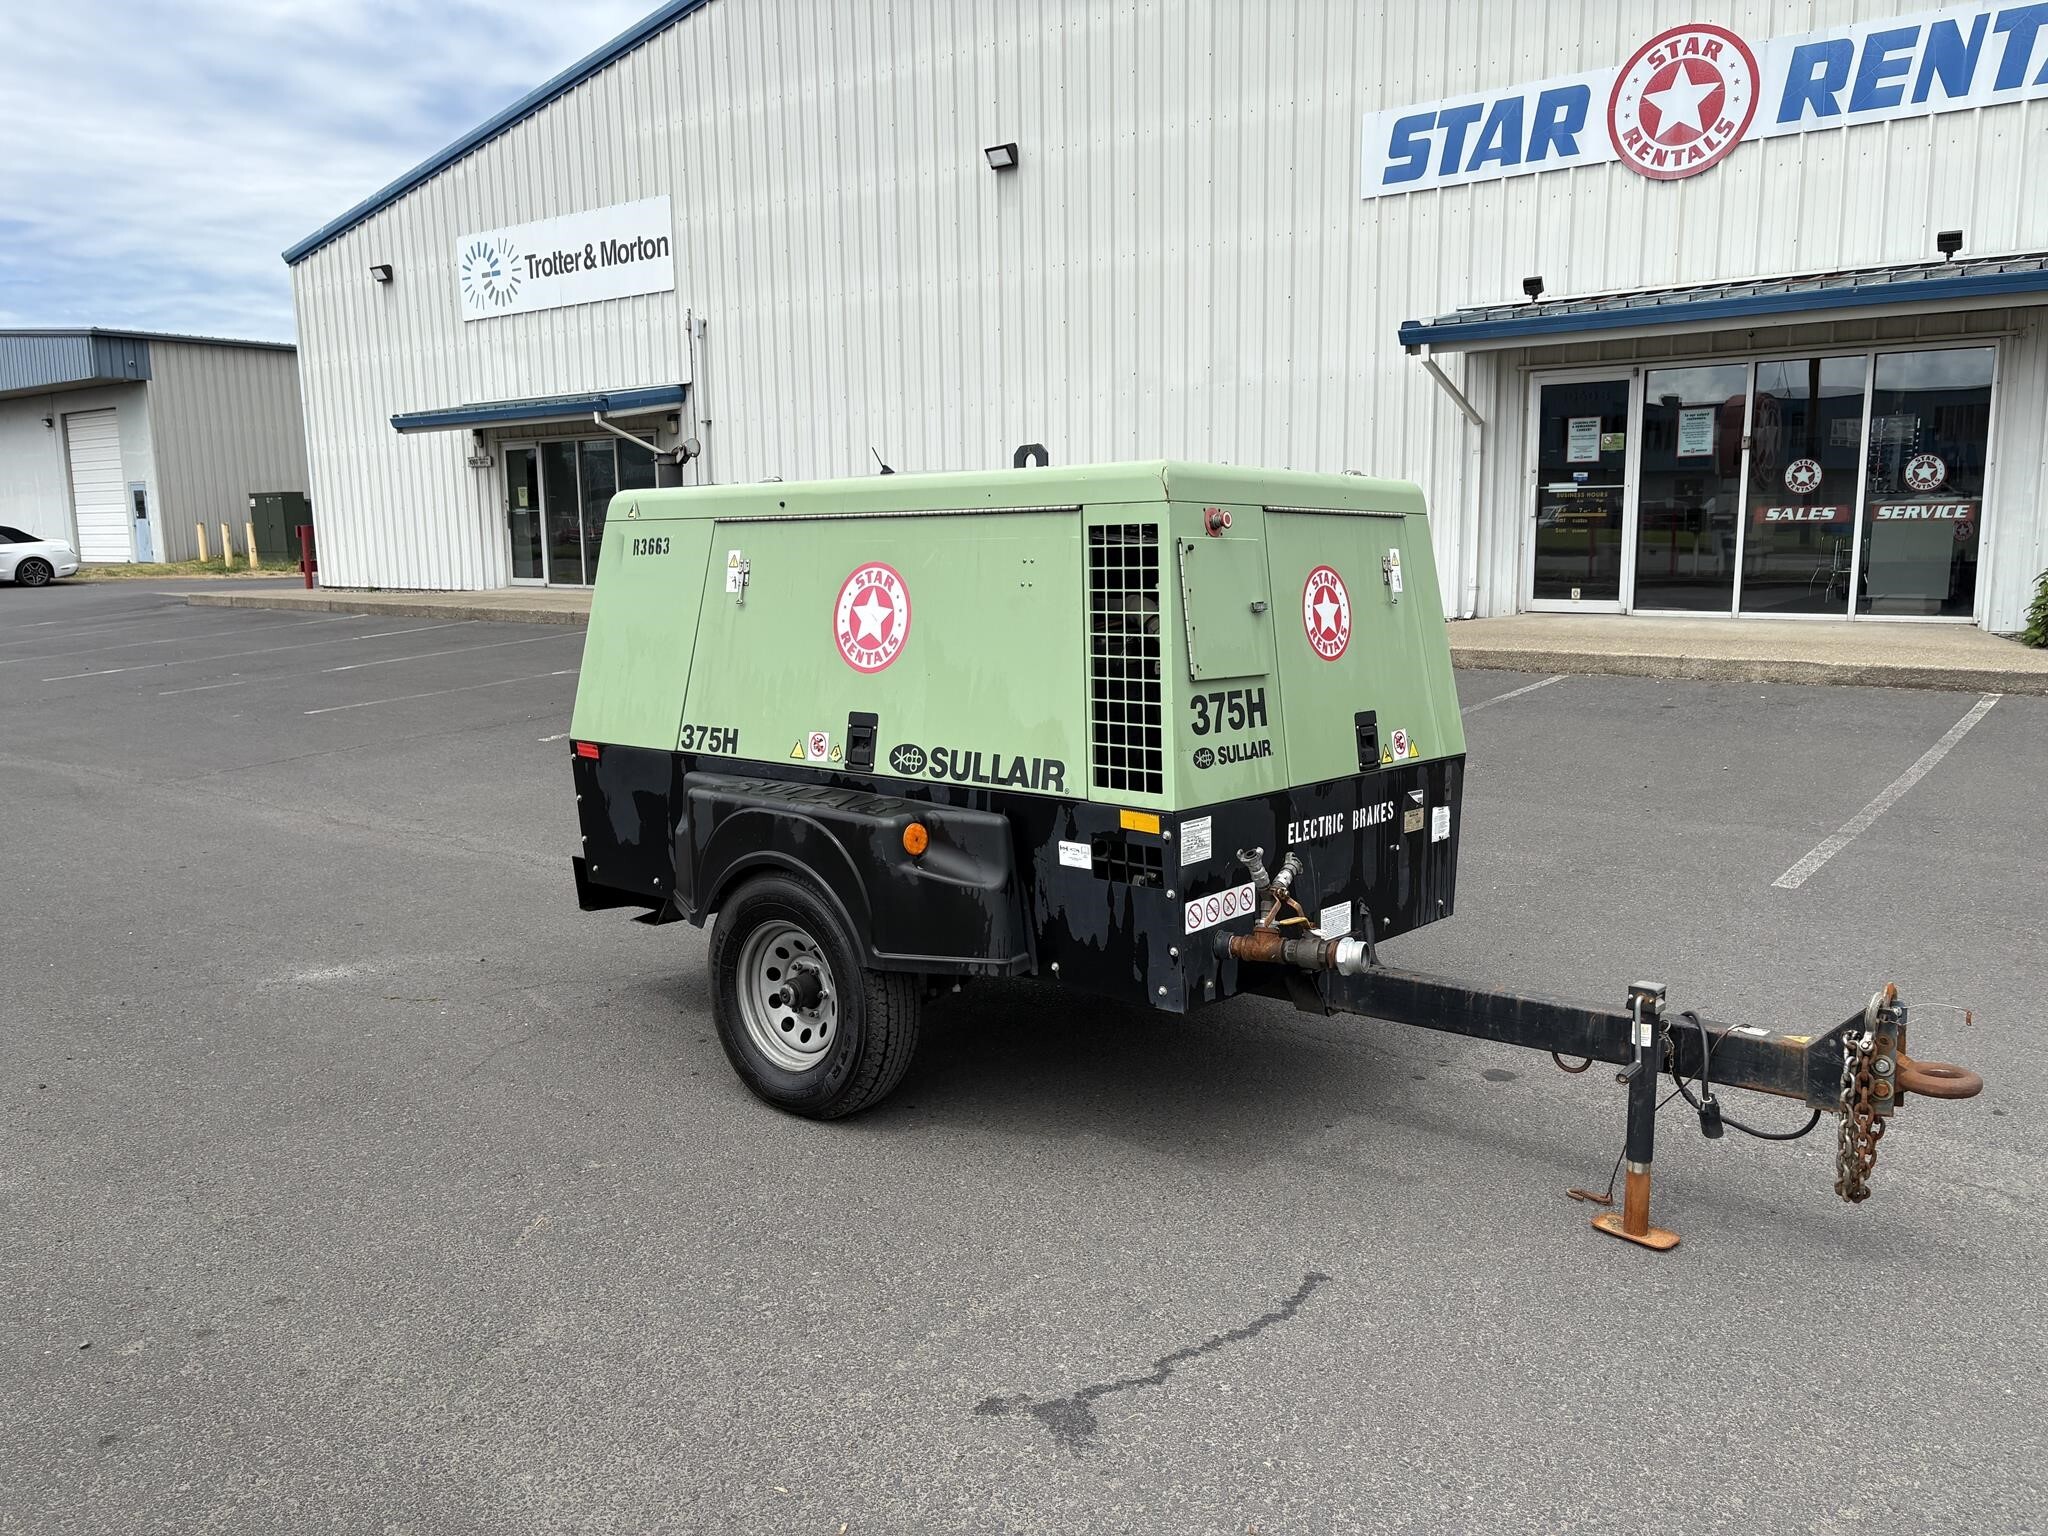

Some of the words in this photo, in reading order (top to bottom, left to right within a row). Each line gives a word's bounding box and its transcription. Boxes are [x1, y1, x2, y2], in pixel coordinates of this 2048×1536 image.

[1647, 36, 1724, 71] STAR
[1382, 84, 1591, 185] STAR
[1622, 117, 1736, 168] RENTALS
[525, 249, 581, 279] Trotter
[584, 243, 597, 270] &
[600, 235, 669, 267] Morton
[1915, 455, 1937, 463] STAR
[1787, 480, 1818, 492] RENTALS
[1907, 477, 1941, 489] RENTALS
[1765, 506, 1837, 521] SALES
[1876, 504, 1970, 520] SERVICE
[633, 537, 670, 556] R3663
[855, 570, 895, 593] STAR
[1311, 572, 1338, 591] STAR
[840, 630, 900, 666] RENTALS
[1309, 625, 1348, 655] RENTALS
[1190, 687, 1268, 736] 375H
[681, 724, 739, 755] 375H
[1217, 739, 1272, 765] SULLAIR
[929, 746, 1066, 793] SULLAIR
[1287, 812, 1344, 845] ELECTRIC
[1352, 800, 1394, 831] BRAKES
